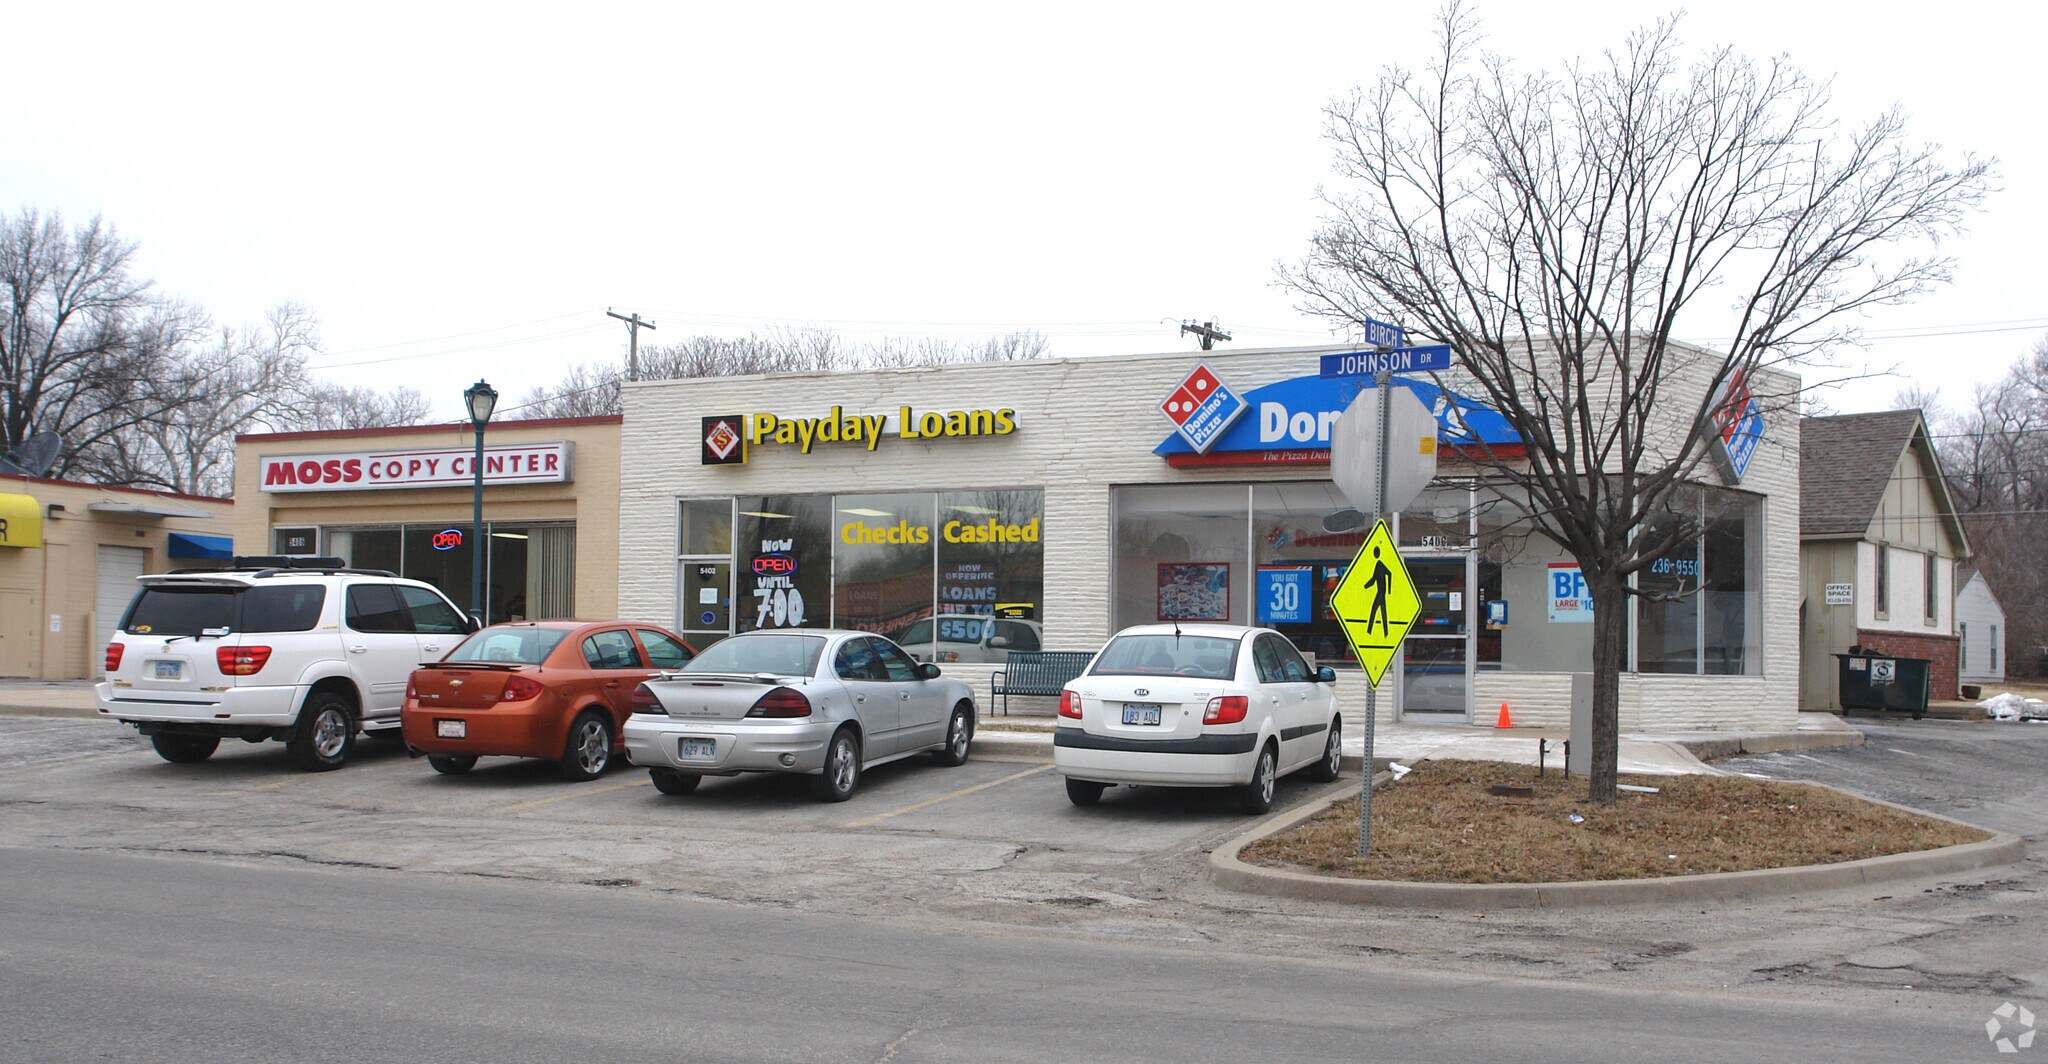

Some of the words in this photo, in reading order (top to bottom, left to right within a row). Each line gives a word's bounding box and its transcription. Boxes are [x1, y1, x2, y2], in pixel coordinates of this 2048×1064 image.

[1370, 323, 1398, 347] BIRCH
[1337, 351, 1412, 375] JOHNSON
[1420, 353, 1432, 364] DR
[1184, 392, 1228, 435] Domino's
[1260, 395, 1468, 443] Do's
[753, 405, 886, 454] Payday
[900, 405, 1016, 439] Loans
[1193, 415, 1222, 444] Pizza
[1263, 451, 1279, 461] The
[1282, 451, 1308, 461] Pizza
[265, 459, 361, 486] MOSS
[369, 458, 440, 479] COPY
[841, 519, 930, 545] Checks
[943, 517, 1039, 544] Cashed
[433, 532, 462, 546] OPEN
[754, 559, 795, 572] OPEN
[958, 564, 981, 572] NOW
[757, 576, 795, 589] UNTIL
[945, 571, 995, 581] OFFERING
[1271, 573, 1285, 582] YOU
[1286, 573, 1298, 582] GOT
[1553, 571, 1593, 598] BF
[942, 586, 997, 601] LOANS
[1270, 582, 1299, 611] 30
[753, 588, 805, 629] 7:00
[972, 603, 995, 616] TO
[1555, 599, 1579, 608] LARGE
[1270, 611, 1298, 620] MINUTES
[941, 619, 996, 640] $500
[1135, 688, 1149, 696] KIA
[1125, 711, 1140, 721] 183
[1144, 711, 1158, 722] ADL
[684, 745, 698, 756] 629
